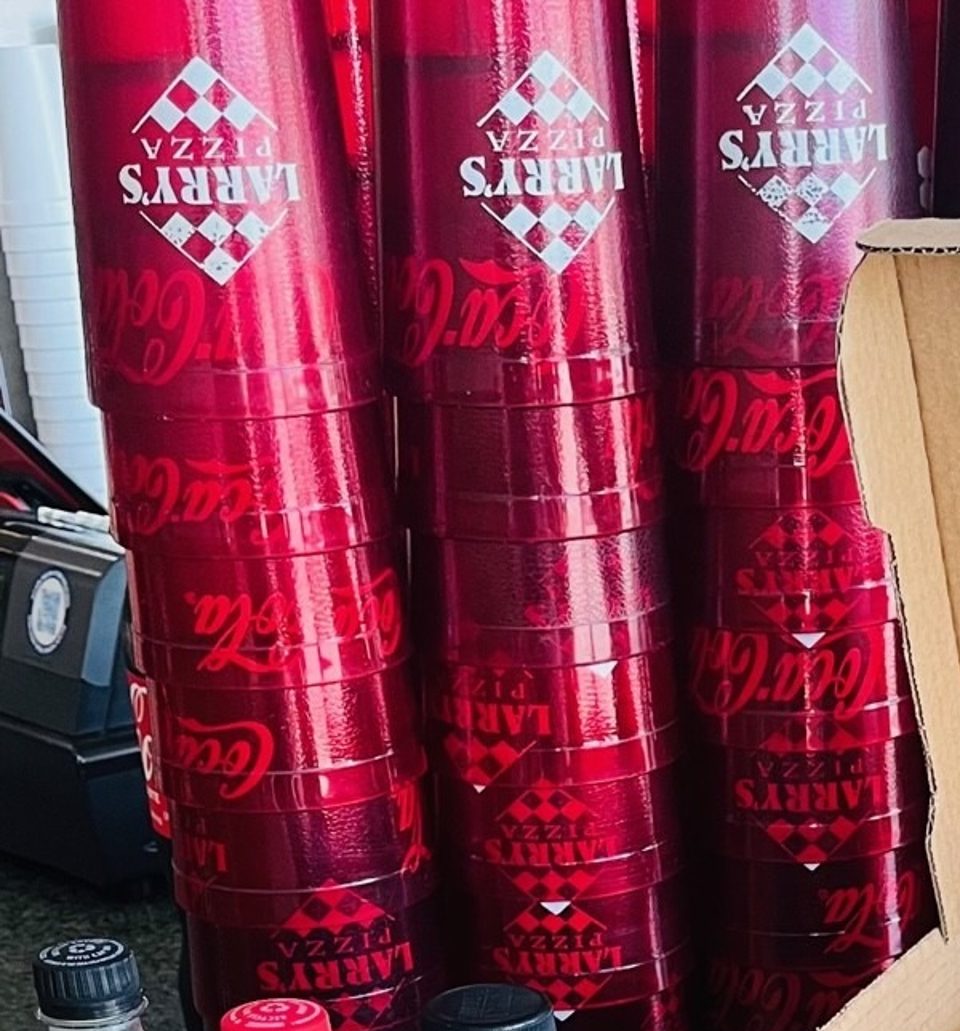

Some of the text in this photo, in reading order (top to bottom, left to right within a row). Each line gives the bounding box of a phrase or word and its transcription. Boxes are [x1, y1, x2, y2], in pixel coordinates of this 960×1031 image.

[742, 98, 866, 126] PIZZA
[140, 135, 273, 160] PIZZA
[486, 126, 605, 152] PIZZA
[718, 123, 889, 171] LARRY'S
[118, 163, 301, 205] LARRY'S
[458, 151, 625, 197] LARRY'S
[277, 927, 392, 958] PIZZA
[256, 940, 415, 992] LARRY'S
